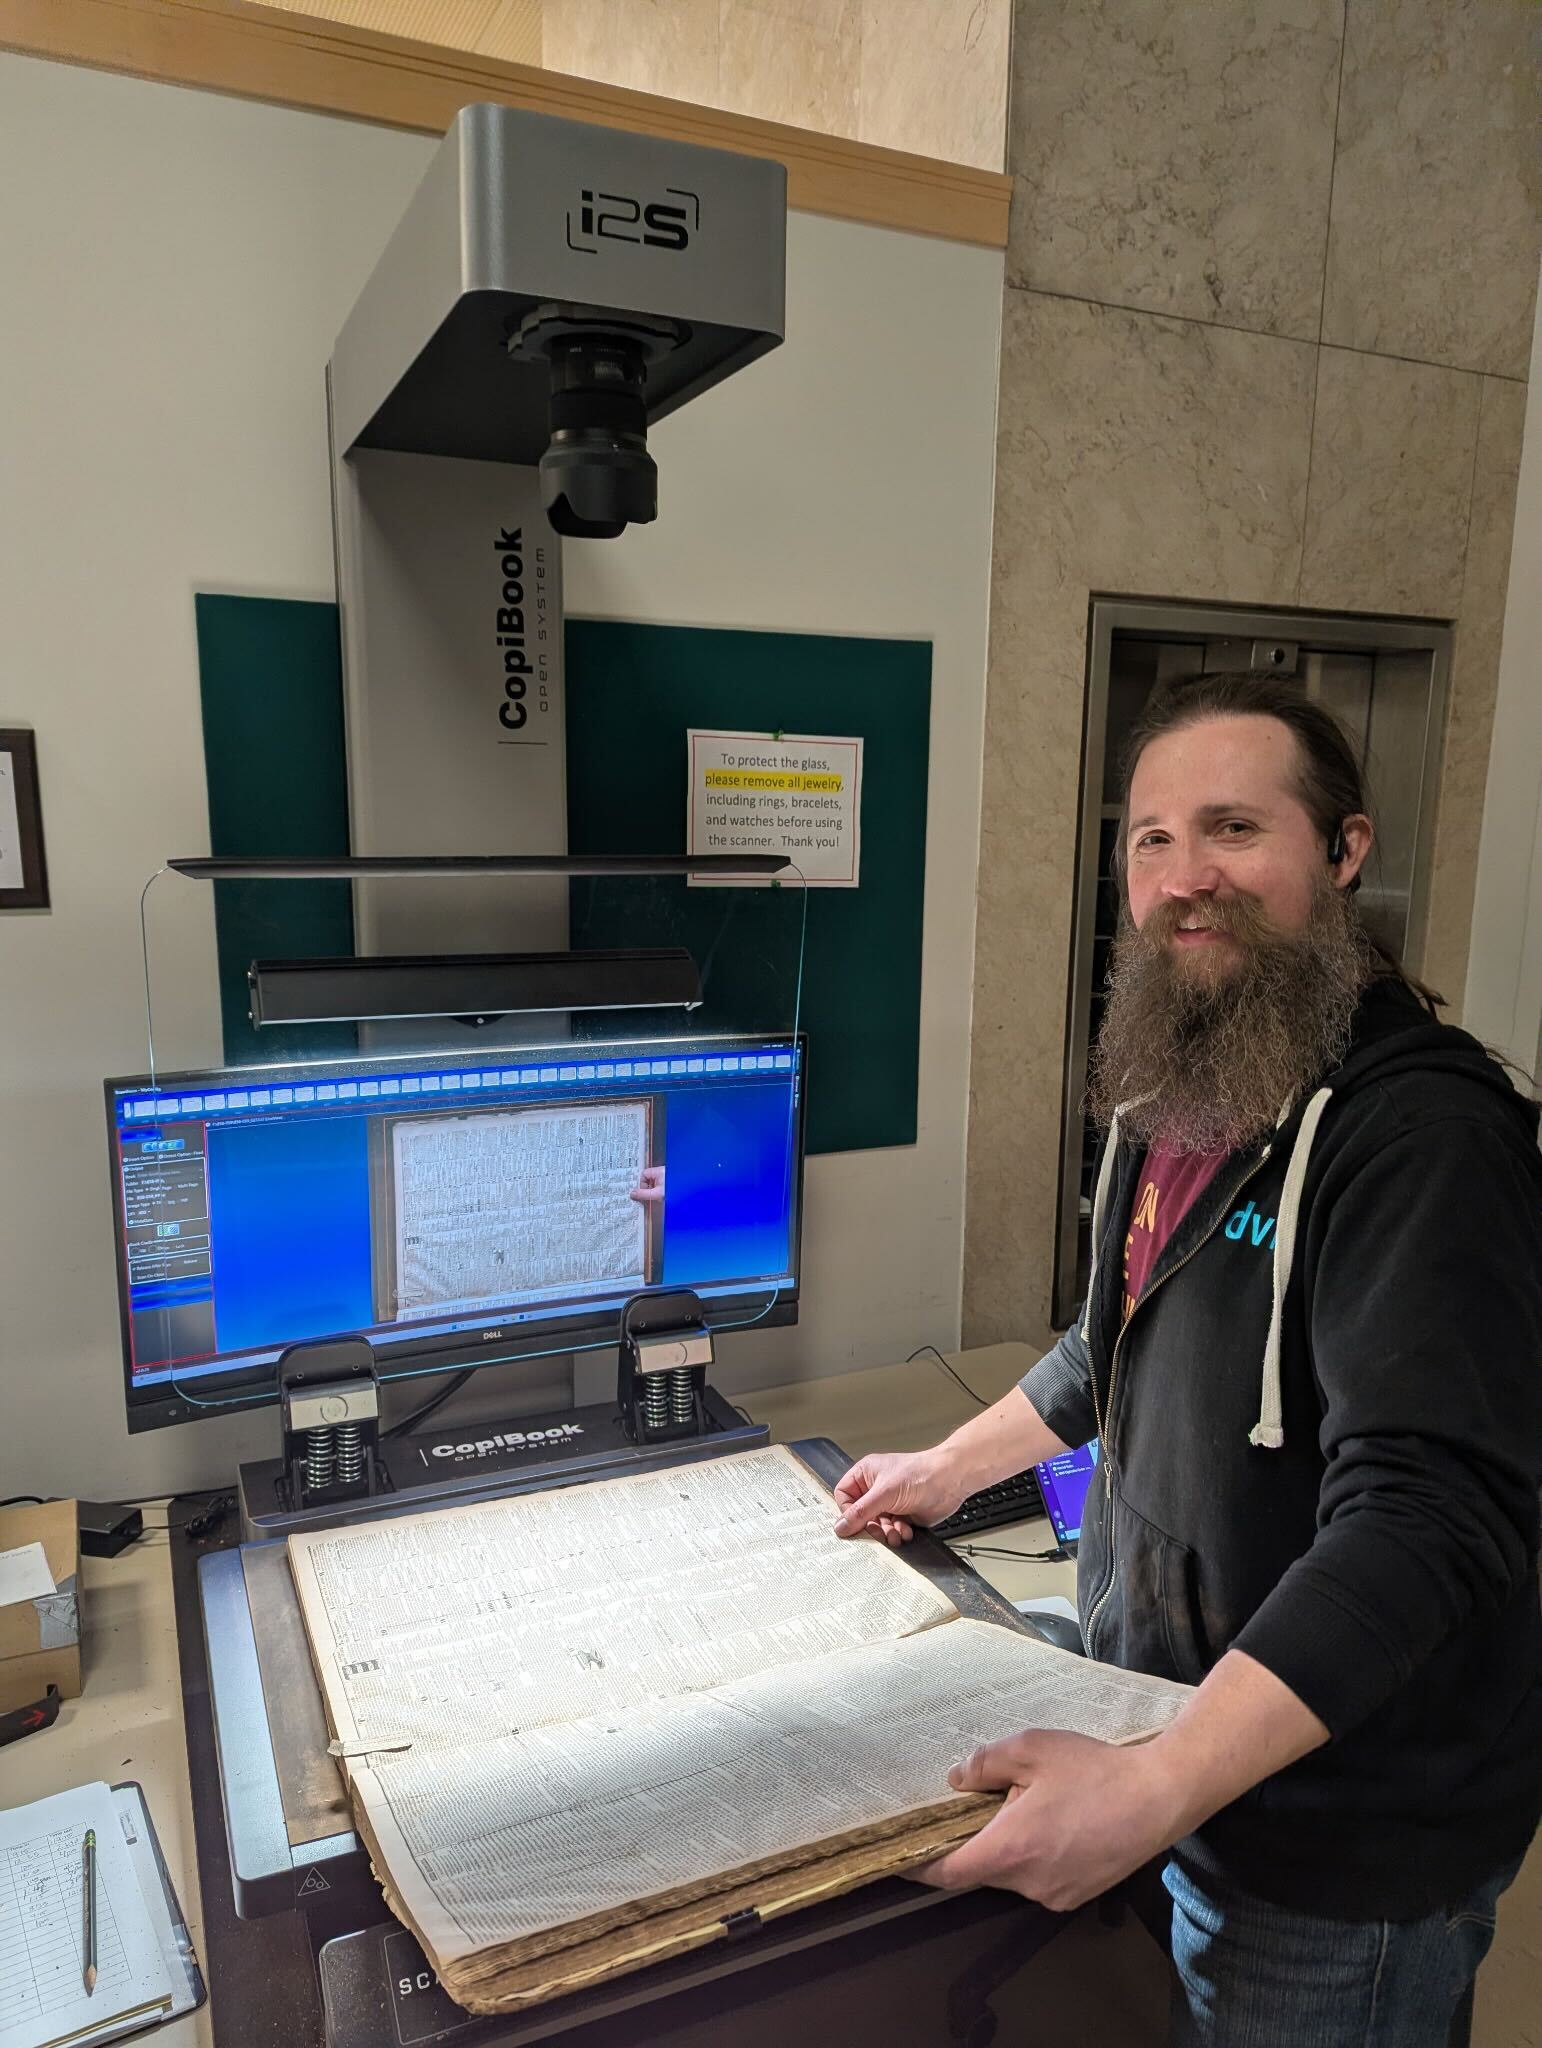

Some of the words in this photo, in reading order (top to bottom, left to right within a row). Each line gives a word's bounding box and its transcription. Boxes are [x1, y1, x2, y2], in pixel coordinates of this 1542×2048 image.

[494, 527, 533, 730] CopiBook
[721, 753, 735, 766] To
[737, 755, 778, 768] protect
[781, 756, 799, 768] the
[801, 758, 830, 771] glass,
[705, 773, 740, 787] please
[743, 777, 785, 788] remove
[788, 776, 800, 787] all
[803, 777, 844, 792] jewelry,
[706, 794, 756, 808] including
[759, 797, 788, 809] rings,
[791, 796, 842, 811] bracelets,
[706, 814, 727, 826] and
[730, 815, 774, 828] watches
[777, 816, 813, 828] before
[815, 818, 843, 831] using
[708, 834, 727, 846] the
[730, 836, 775, 848] scanner.
[781, 835, 814, 848] Thank
[816, 836, 840, 850] you!
[483, 1330, 503, 1341] DELL
[431, 1423, 585, 1458] CopiBook
[399, 1972, 440, 1995] SC
